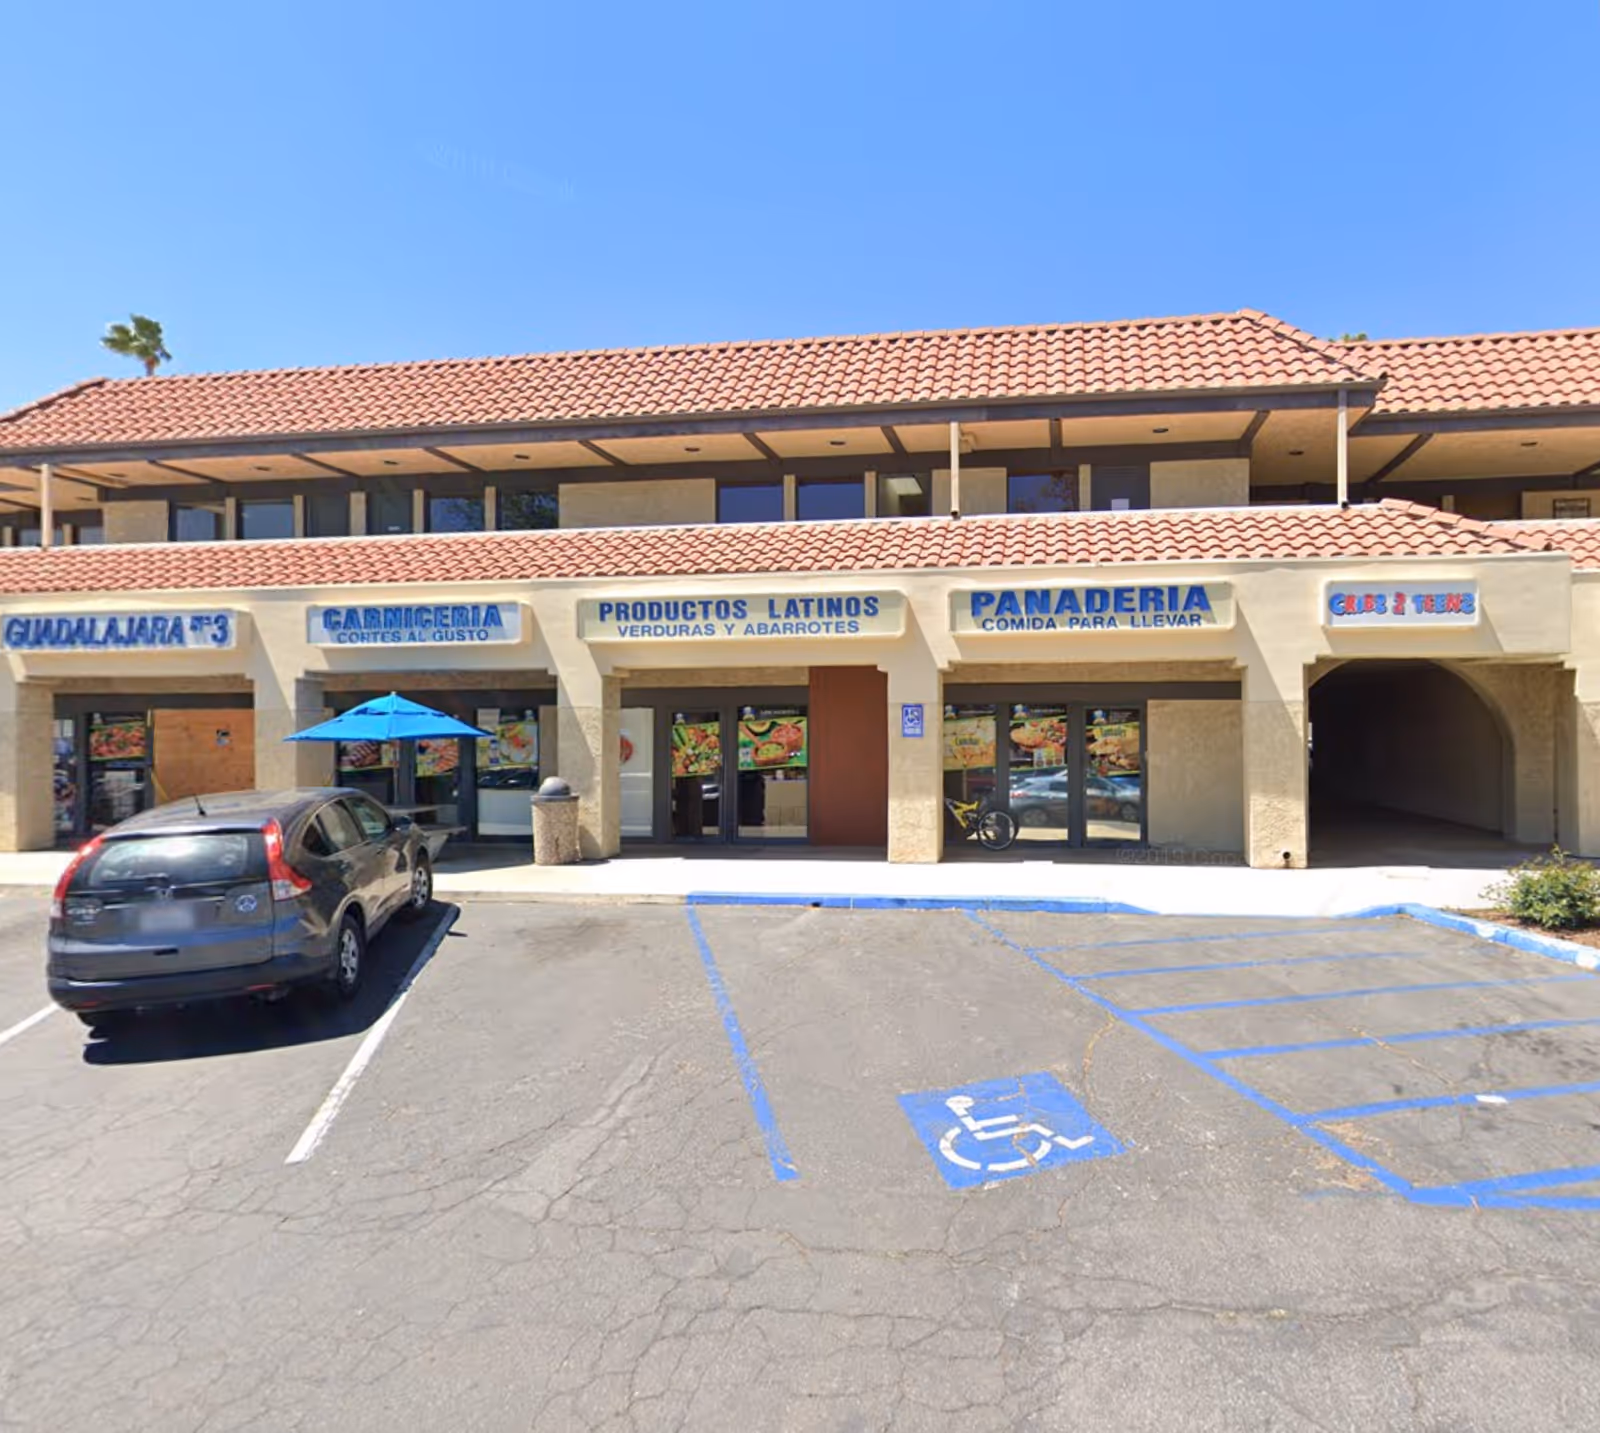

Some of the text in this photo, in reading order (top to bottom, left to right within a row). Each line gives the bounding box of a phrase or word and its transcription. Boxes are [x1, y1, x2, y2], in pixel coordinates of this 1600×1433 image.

[599, 596, 879, 622] PRODUCTOS LATINOS
[970, 586, 1212, 617] PANADERIA
[1393, 592, 1406, 615] 2
[322, 604, 503, 631] CARNICERIA
[617, 619, 860, 638] VERDURAS Y ABARROTES
[982, 613, 1202, 631] COMIDA PARA LLEVAR
[5, 616, 184, 647] GUADALAJARA
[337, 628, 489, 644] CORTES AL GUSTO
